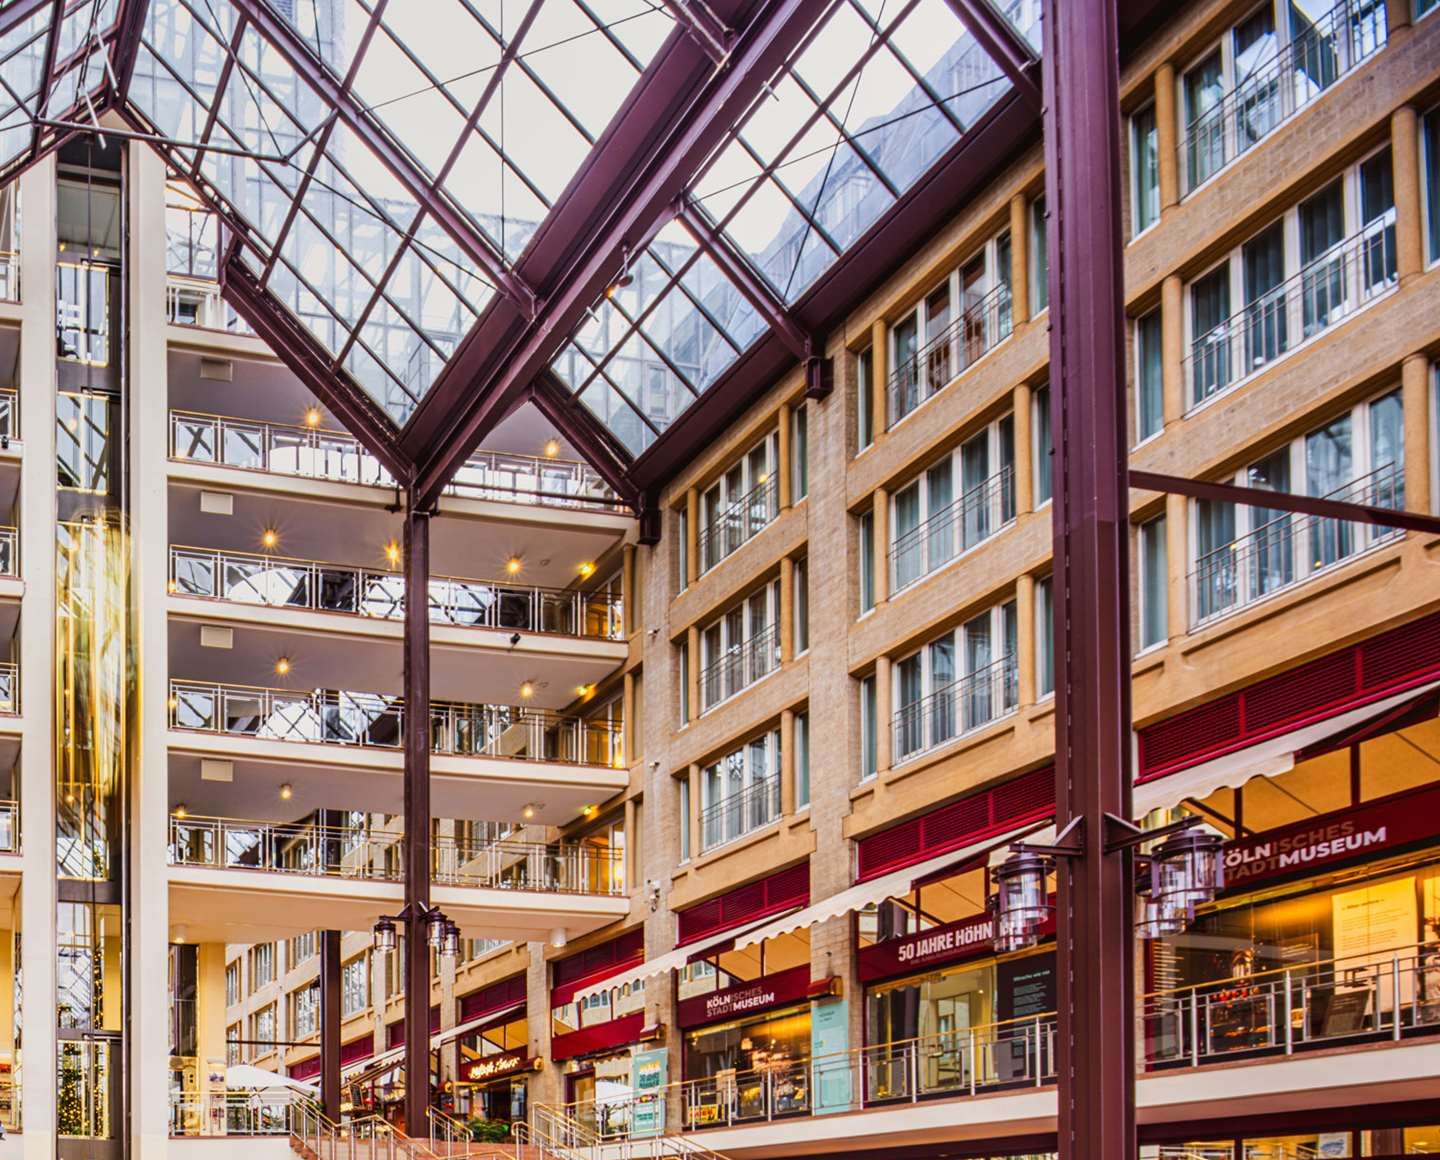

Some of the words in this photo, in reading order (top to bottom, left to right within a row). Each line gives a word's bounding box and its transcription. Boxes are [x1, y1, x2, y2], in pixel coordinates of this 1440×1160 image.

[1222, 820, 1356, 869] ÖLNISCHES
[1224, 826, 1387, 880] TADTMUSEUM
[898, 943, 915, 962] 50
[916, 932, 955, 957] JAHRE
[706, 992, 775, 1018] STADTMUSEUM
